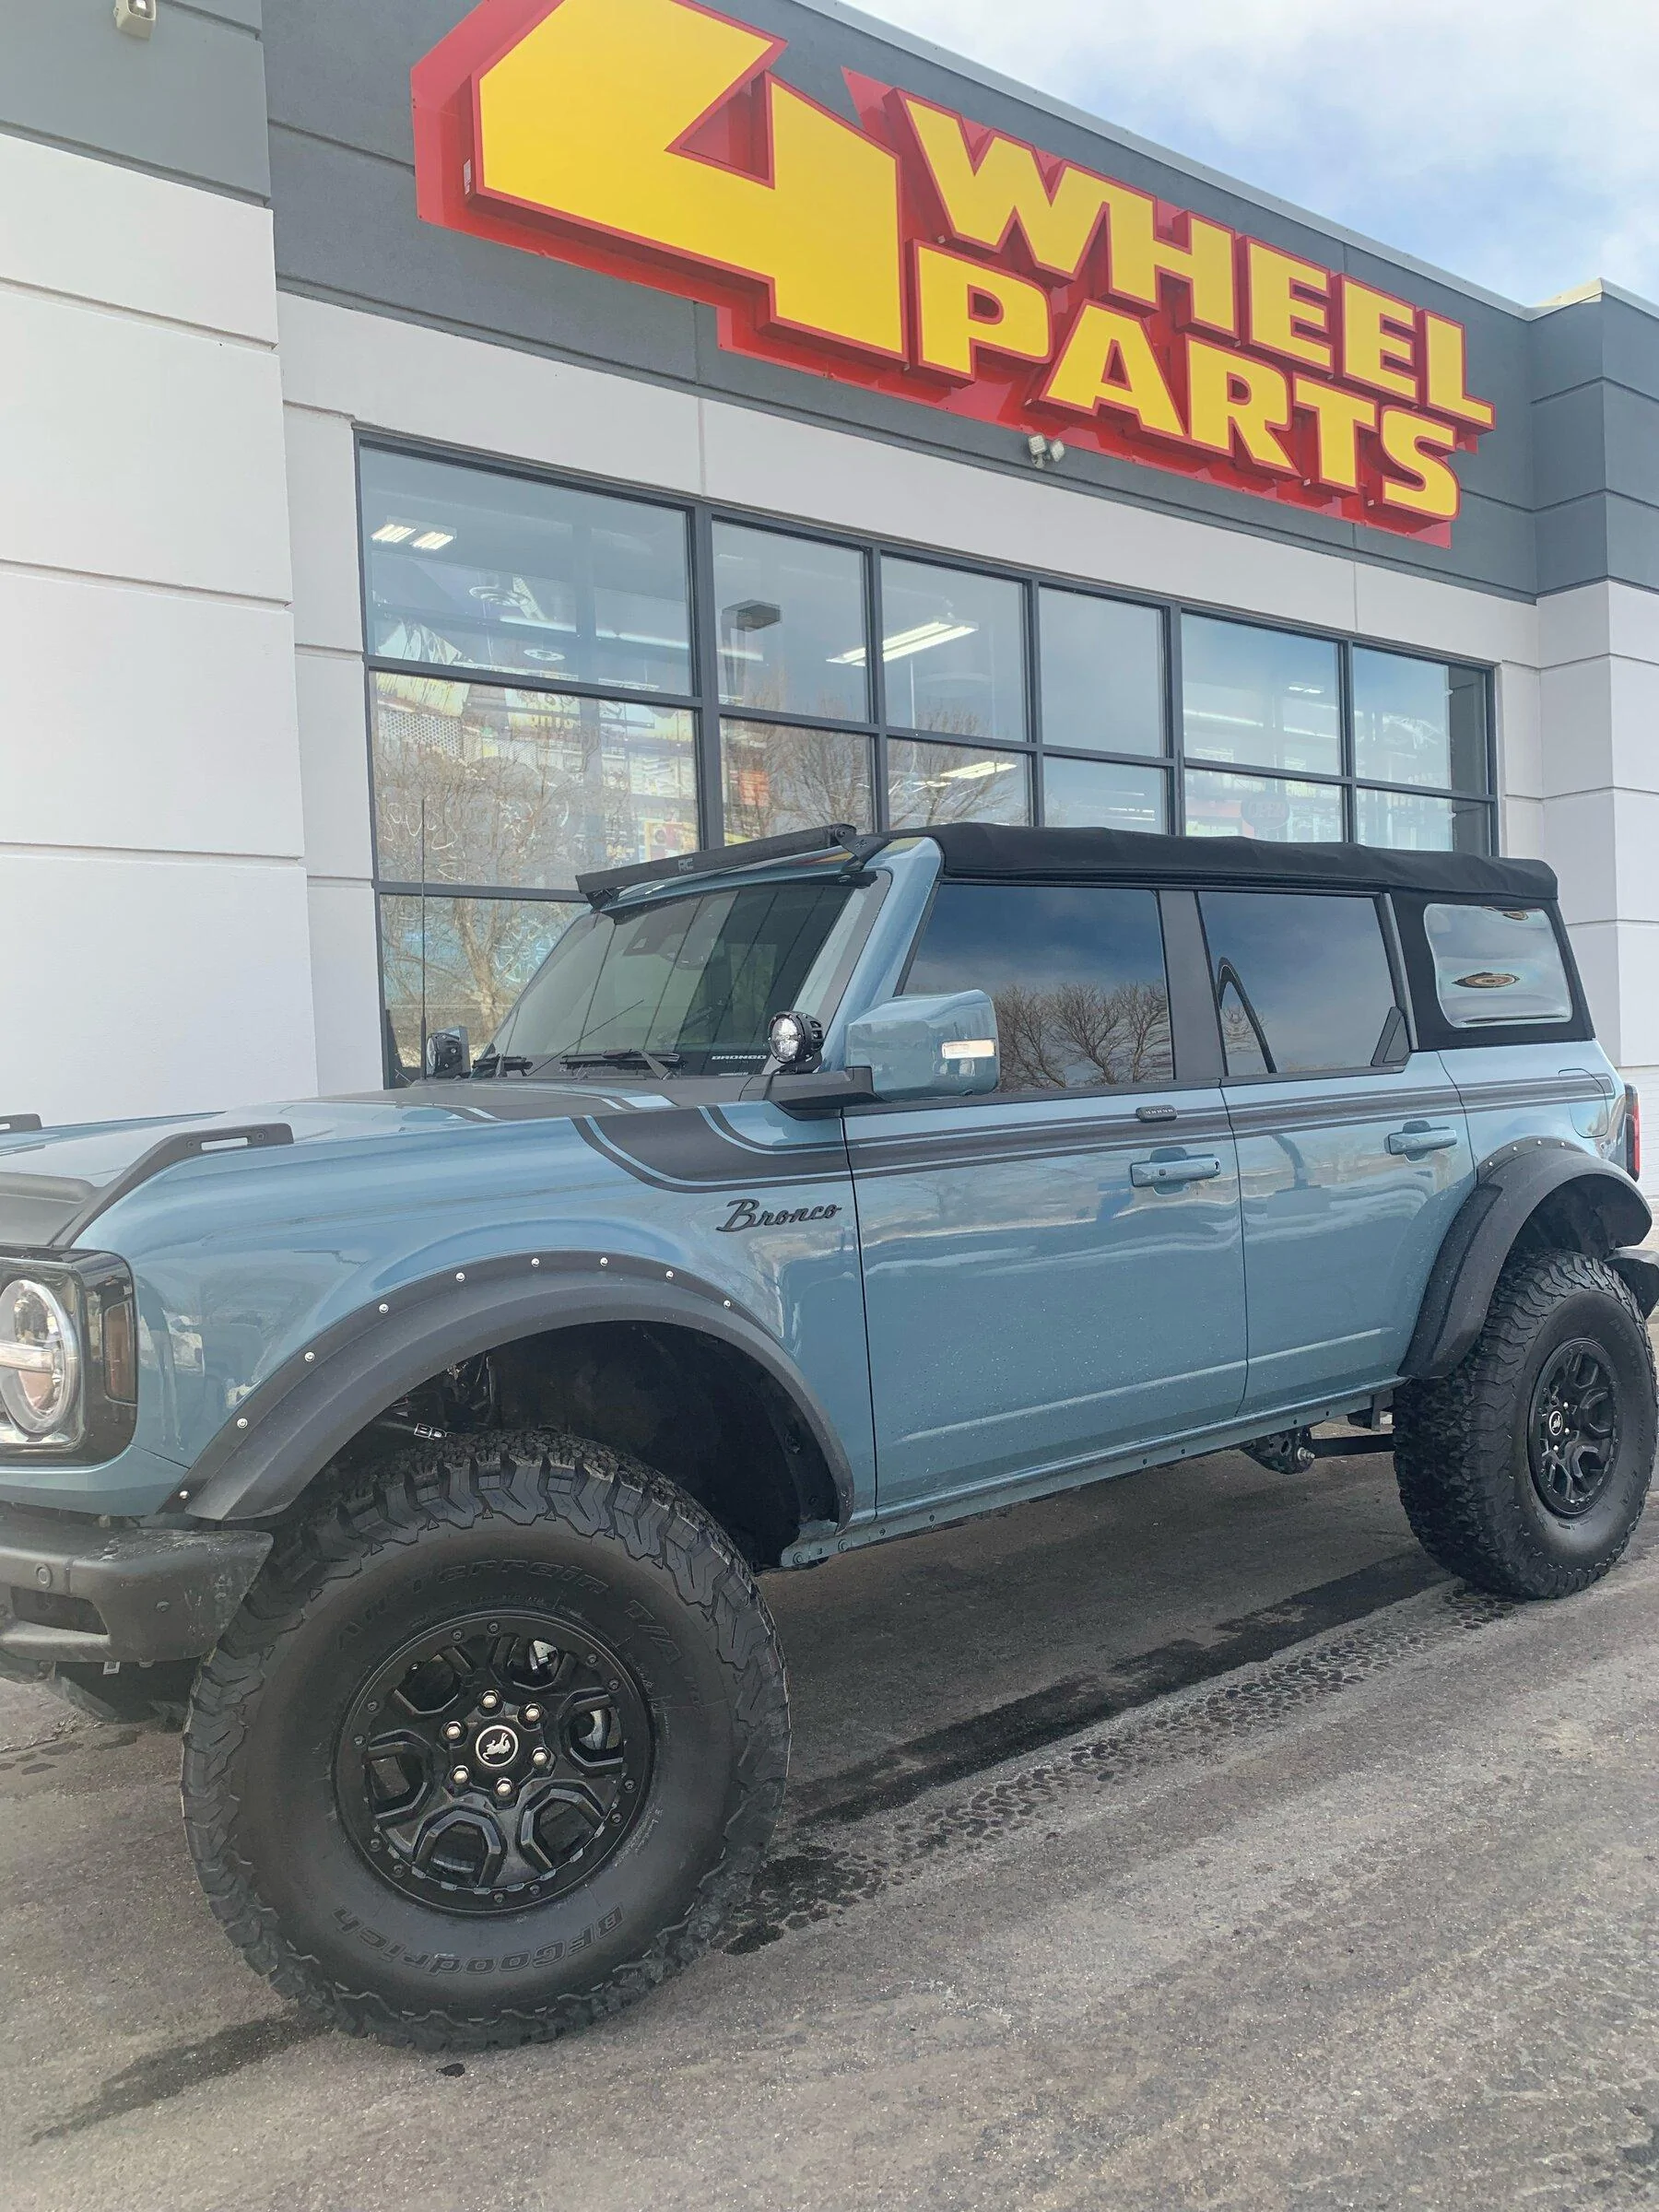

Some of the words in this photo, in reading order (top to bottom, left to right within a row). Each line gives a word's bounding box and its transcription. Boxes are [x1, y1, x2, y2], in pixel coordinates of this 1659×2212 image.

[477, 0, 903, 354] 4
[906, 99, 1492, 422] WHEEL
[917, 248, 1458, 519] PARTS
[716, 1198, 842, 1232] Bronco
[333, 1900, 624, 1975] BFGoodrich
